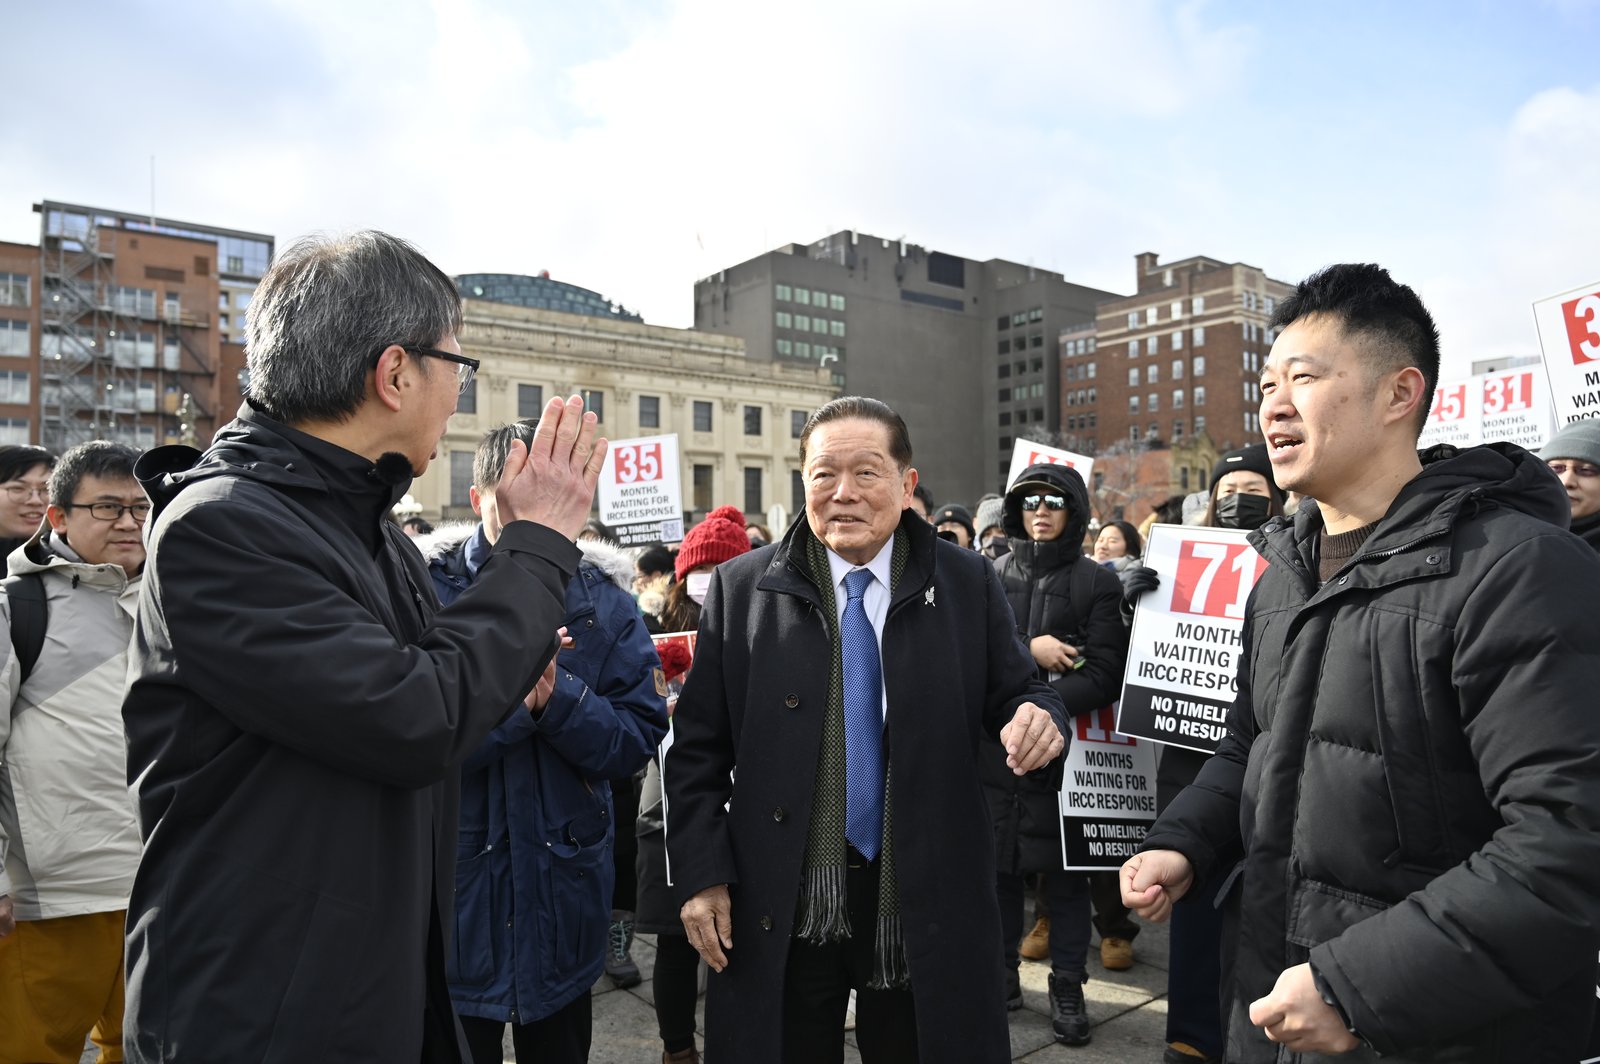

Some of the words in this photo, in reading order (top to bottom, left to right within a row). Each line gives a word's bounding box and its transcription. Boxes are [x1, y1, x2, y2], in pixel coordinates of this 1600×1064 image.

[1483, 375, 1527, 414] 31
[1516, 425, 1538, 434] FOR
[619, 445, 658, 483] 35
[621, 487, 658, 497] MONTHS
[611, 498, 649, 509] WAITING
[651, 496, 669, 505] FOR
[608, 511, 627, 520] IRCC
[627, 506, 675, 518] RESPONSE
[616, 527, 628, 535] NO
[621, 536, 632, 544] NO
[1189, 542, 1258, 617] 71
[1154, 641, 1230, 668] WAITING
[1138, 661, 1178, 682] IRCC
[1150, 695, 1173, 712] NO
[1175, 699, 1228, 723] TIMELI
[1154, 714, 1177, 732] NO
[1085, 750, 1133, 769] MONTHS
[1074, 770, 1123, 790] WAITING
[1125, 774, 1147, 791] FOR
[1068, 791, 1096, 808] IRCC
[1097, 793, 1155, 812] RESPONSE
[1083, 823, 1097, 838] NO
[1098, 824, 1147, 840] TIMELINES
[1088, 841, 1104, 856] NO
[1105, 842, 1142, 857] RESULT
